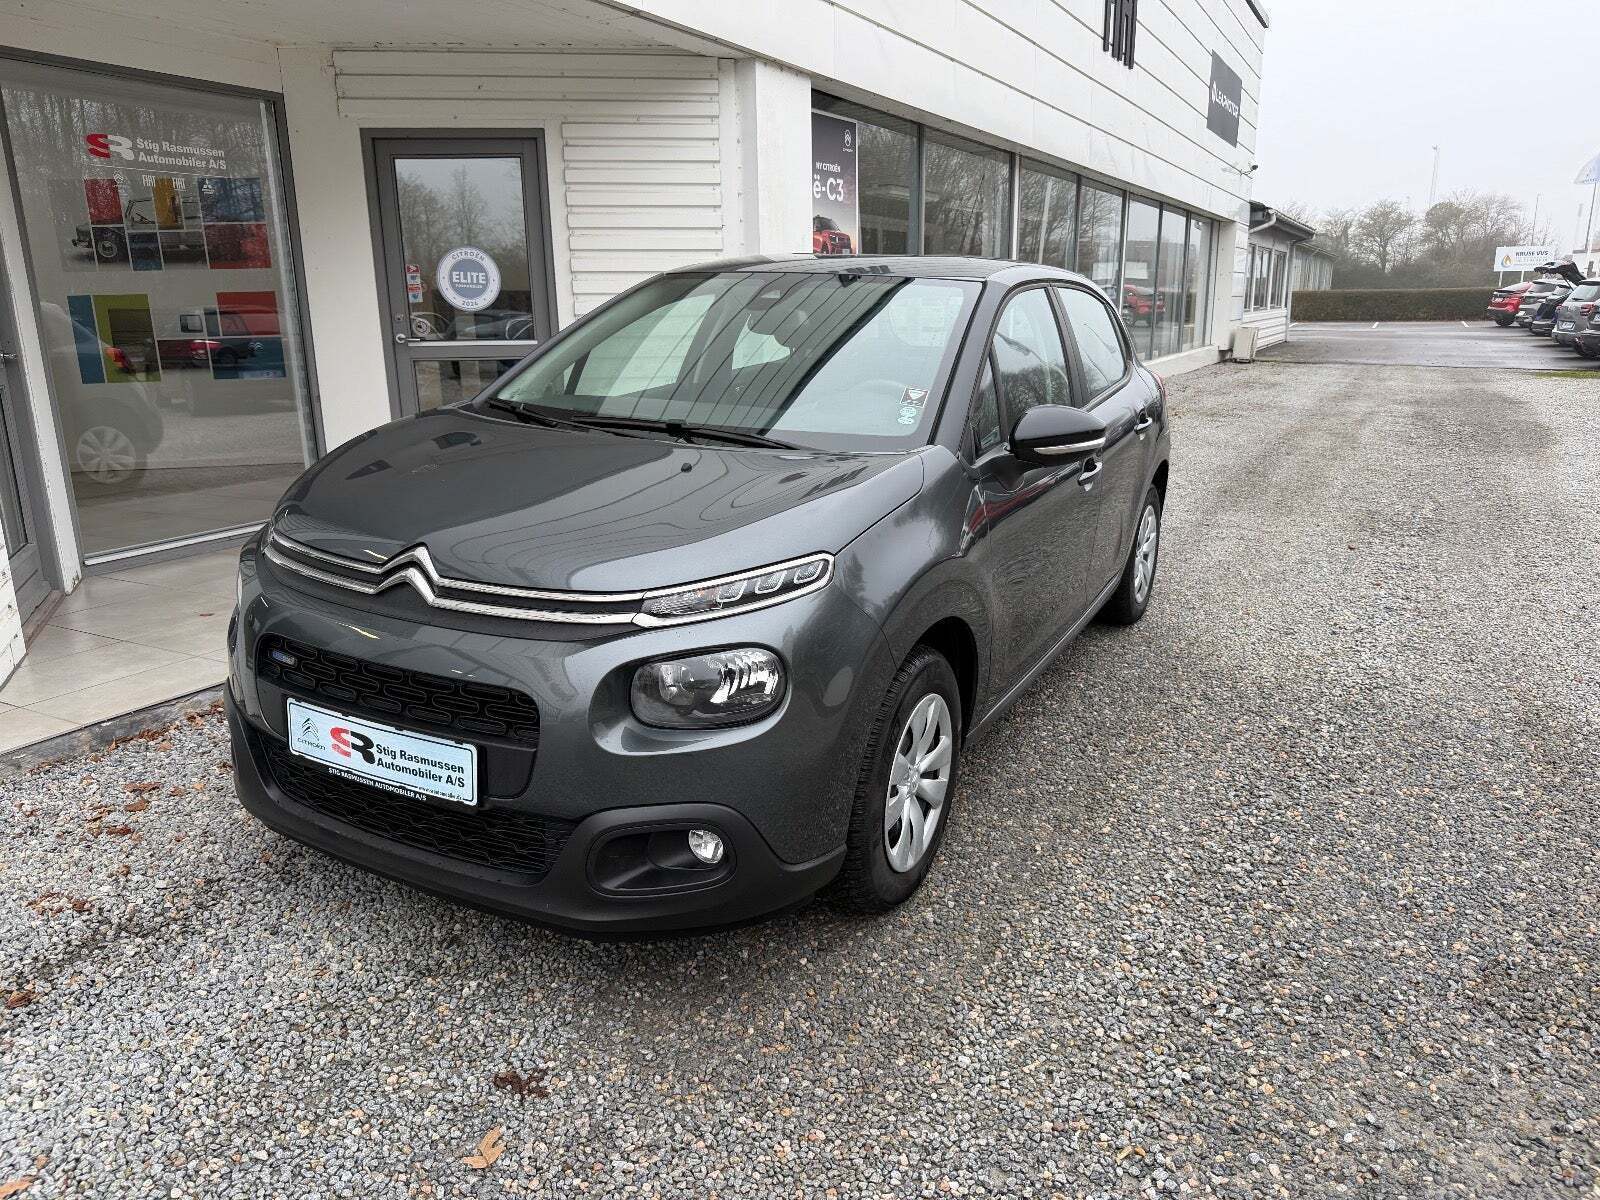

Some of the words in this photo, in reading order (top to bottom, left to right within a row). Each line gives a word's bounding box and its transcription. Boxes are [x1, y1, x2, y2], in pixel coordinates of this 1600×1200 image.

[136, 138, 160, 151] Stig
[162, 142, 225, 157] Rasmussen
[138, 152, 207, 168] Automobiler
[209, 159, 227, 170] A/S
[815, 161, 823, 170] NY
[823, 162, 841, 173] CITROËN
[142, 174, 156, 187] FIAT
[813, 174, 844, 202] ë-C3
[452, 271, 487, 284] ELITE
[376, 743, 397, 759] Stig
[399, 749, 465, 774] Rasmussen
[376, 757, 443, 783] Automobiler
[445, 775, 465, 788] A/S
[328, 767, 341, 777] STIG
[341, 771, 374, 787] RASMUSSEN
[374, 781, 415, 798] AUTOMOBILER
[415, 792, 427, 801] A/S
